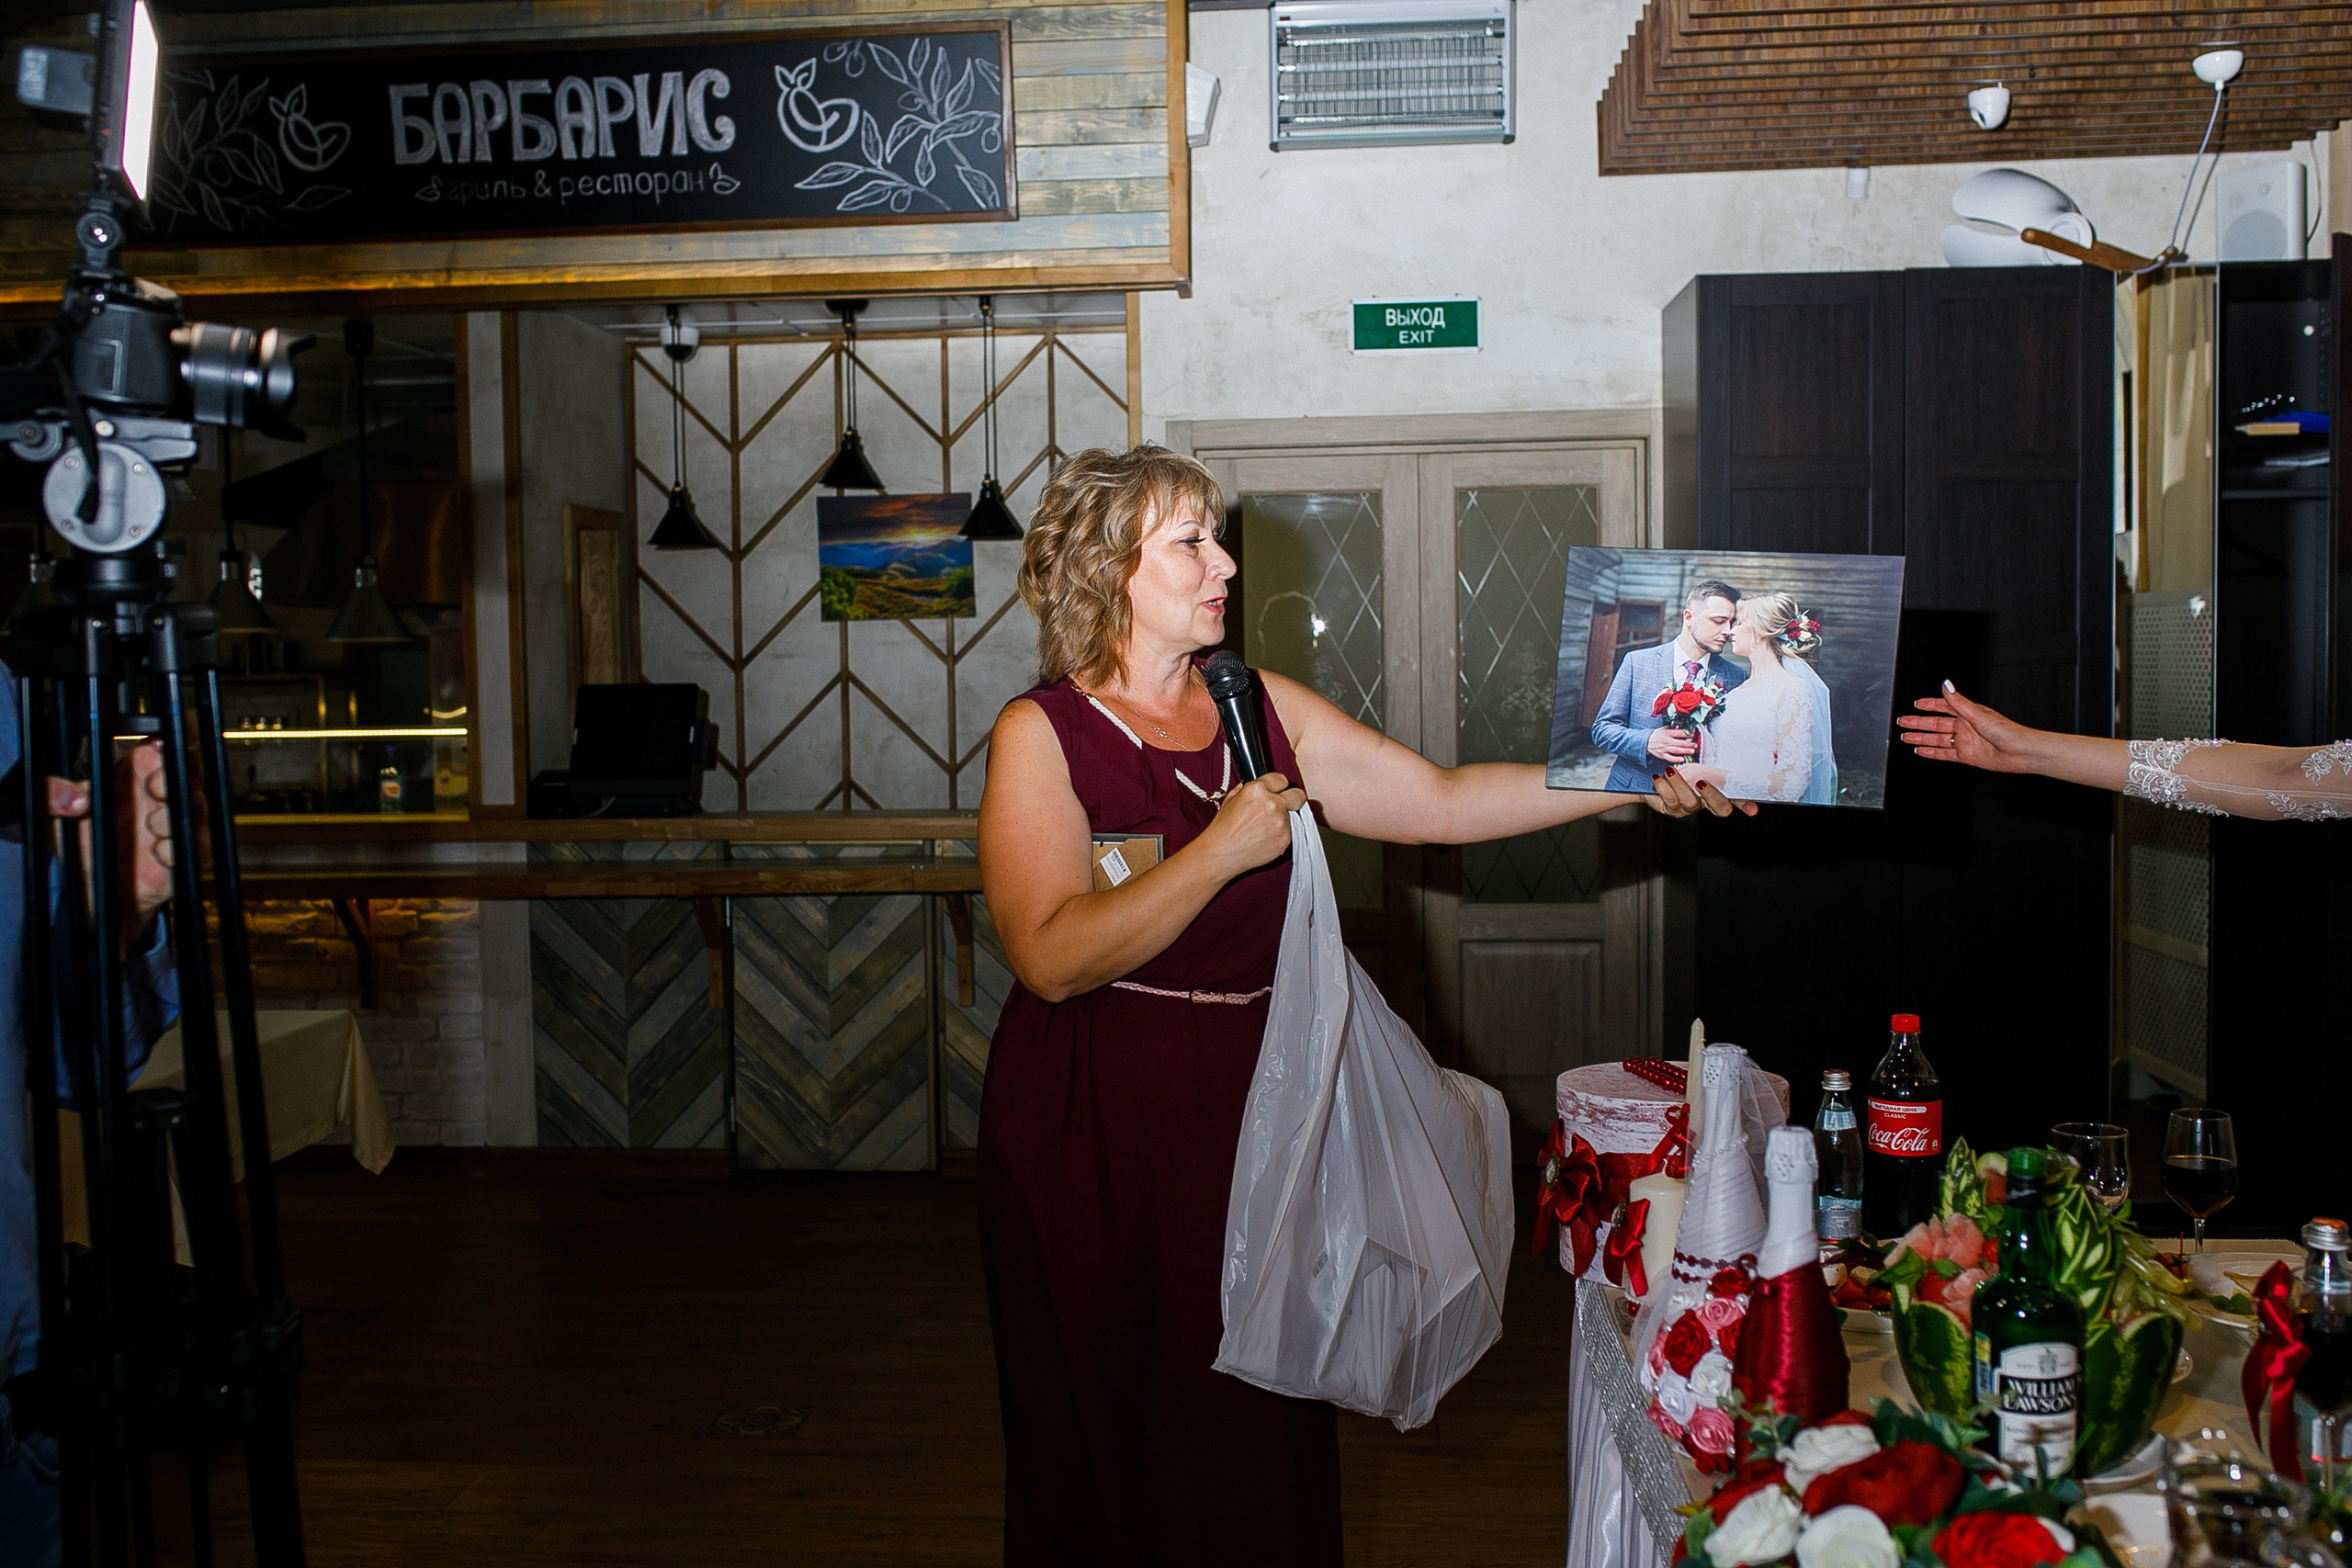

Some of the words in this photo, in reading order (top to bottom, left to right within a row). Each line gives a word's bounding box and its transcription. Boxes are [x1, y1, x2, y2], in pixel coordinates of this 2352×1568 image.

[389, 68, 735, 164] БАРБАРИС
[559, 169, 704, 206] ресторан
[1385, 307, 1446, 329] ВЫХОД
[1399, 330, 1434, 344] EXIT
[1868, 1122, 1931, 1152] Coca-Cola
